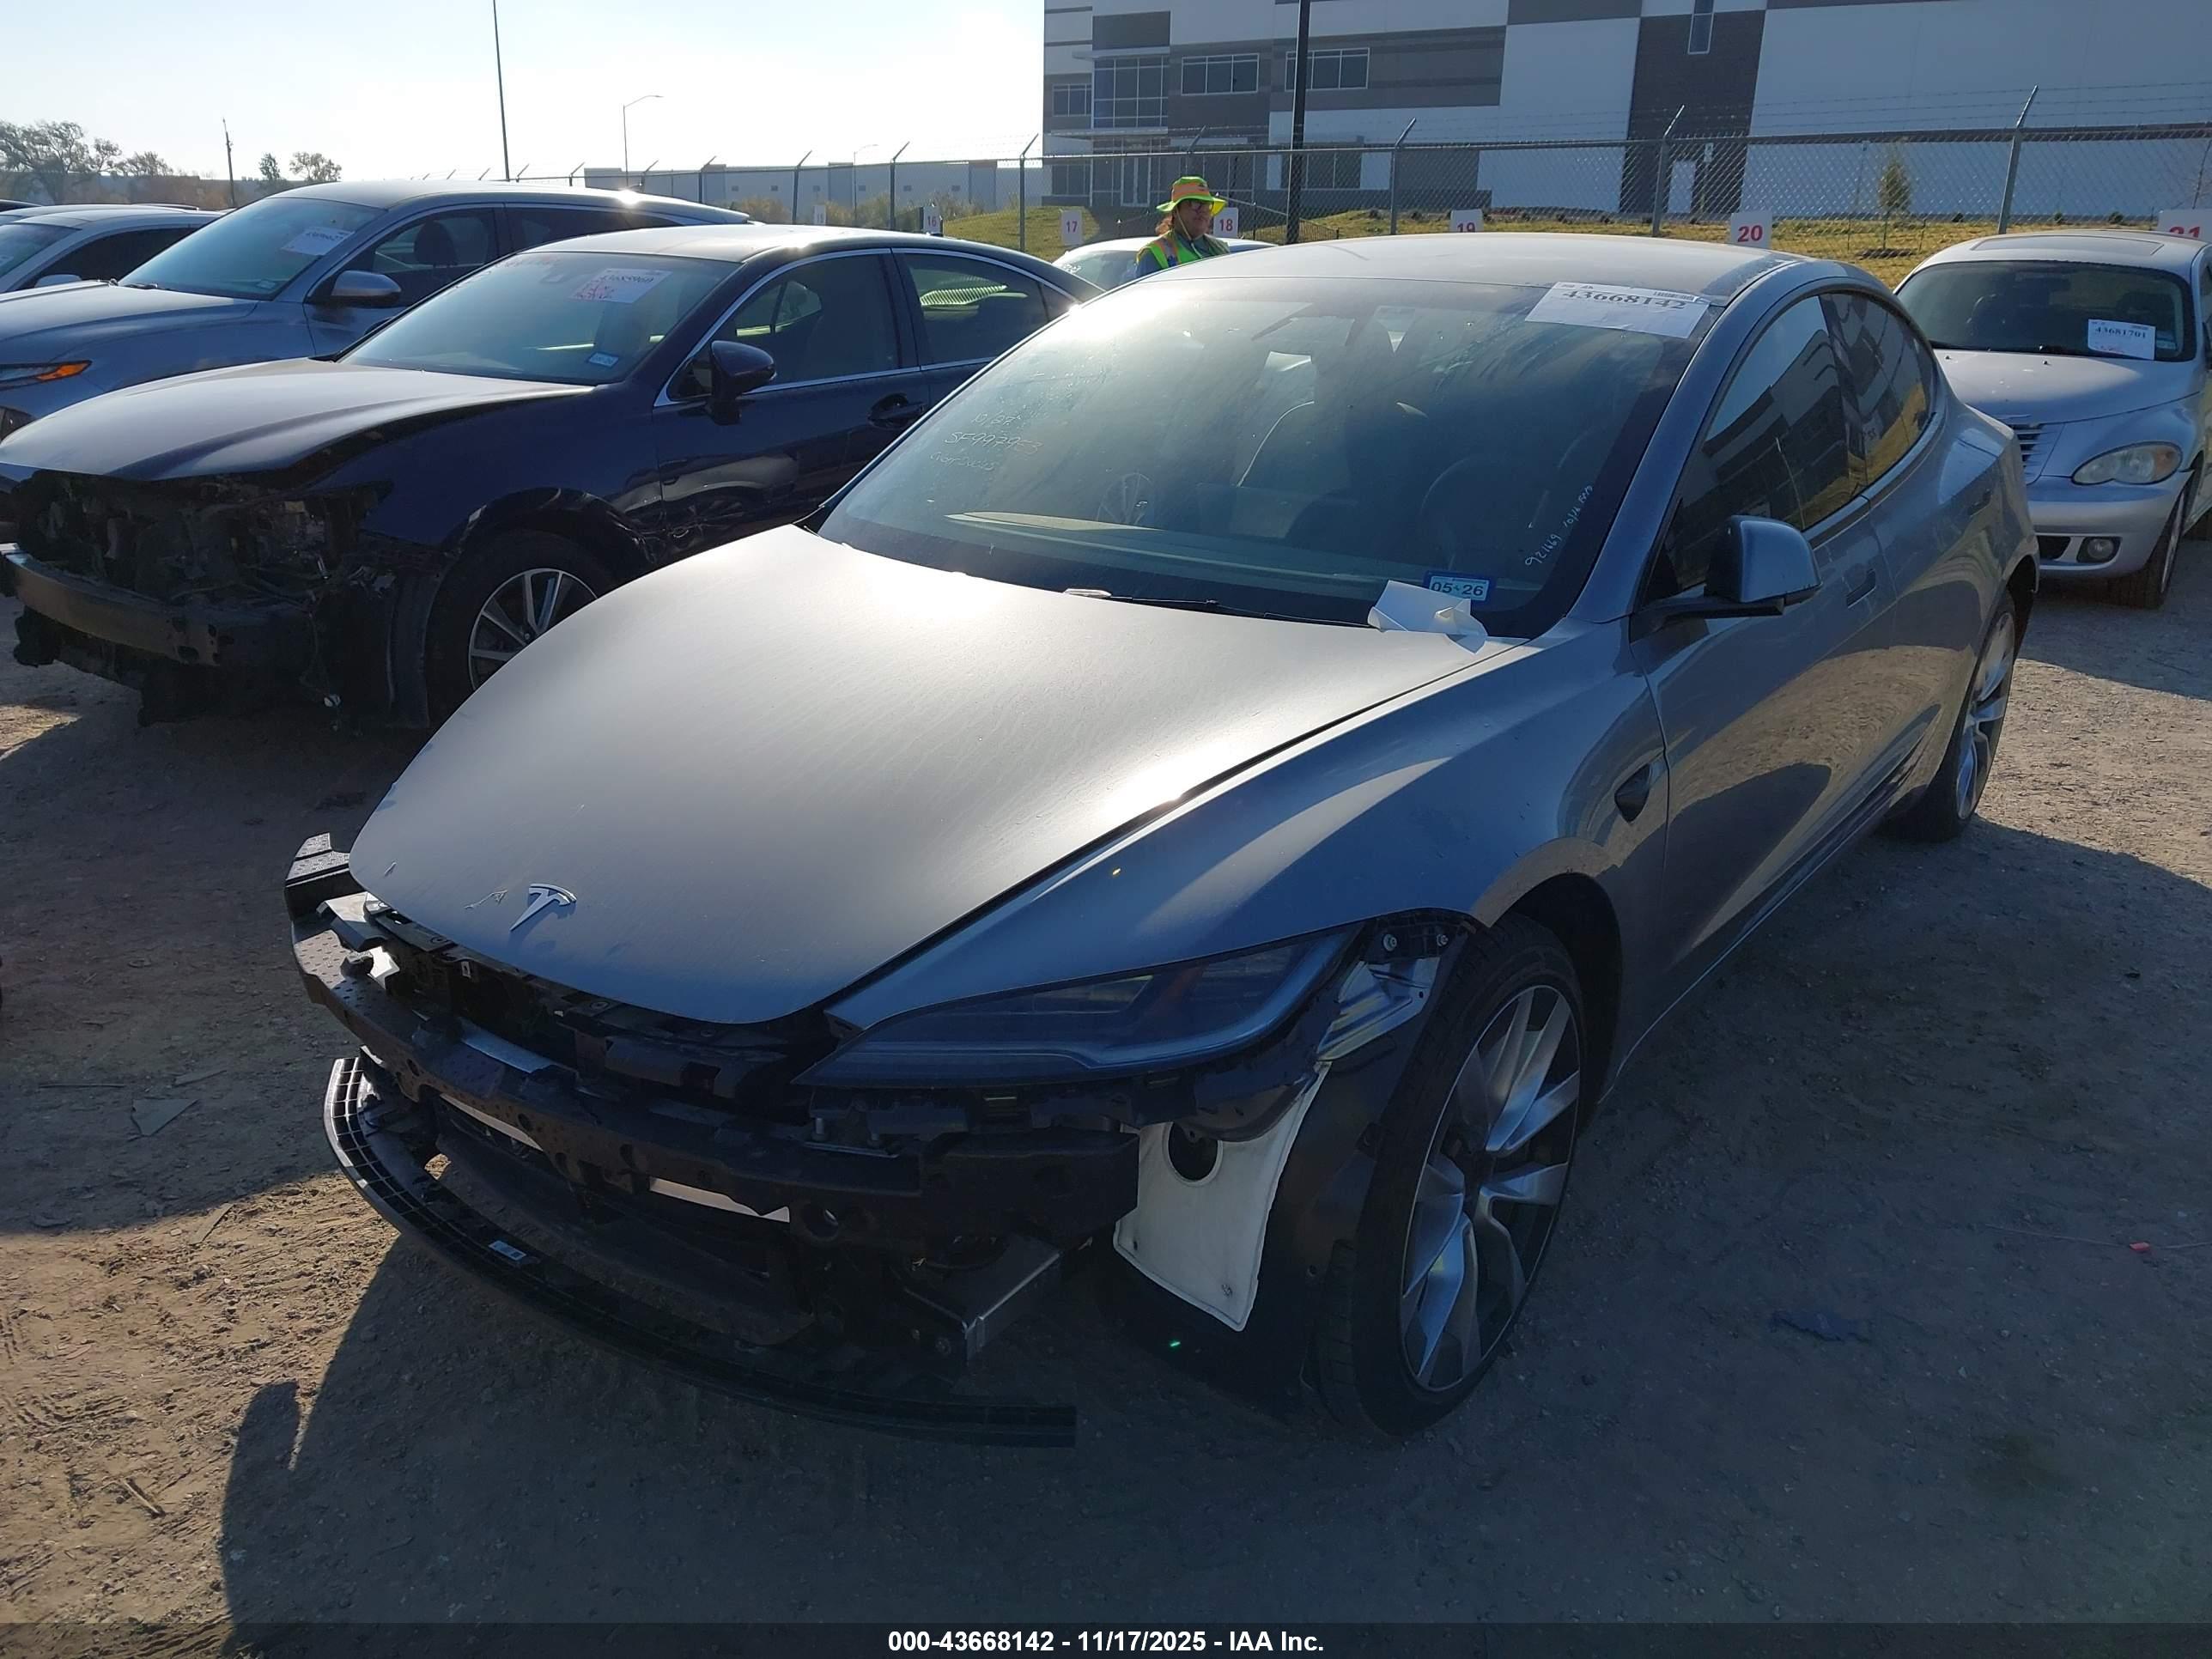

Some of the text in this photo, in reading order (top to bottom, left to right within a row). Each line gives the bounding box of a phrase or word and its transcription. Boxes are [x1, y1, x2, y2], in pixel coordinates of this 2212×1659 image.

[927, 216, 937, 228] 16
[1066, 221, 1078, 233] 17
[1219, 218, 1233, 232] 18
[1738, 225, 1763, 242] 20
[1563, 290, 1686, 309] 43668142
